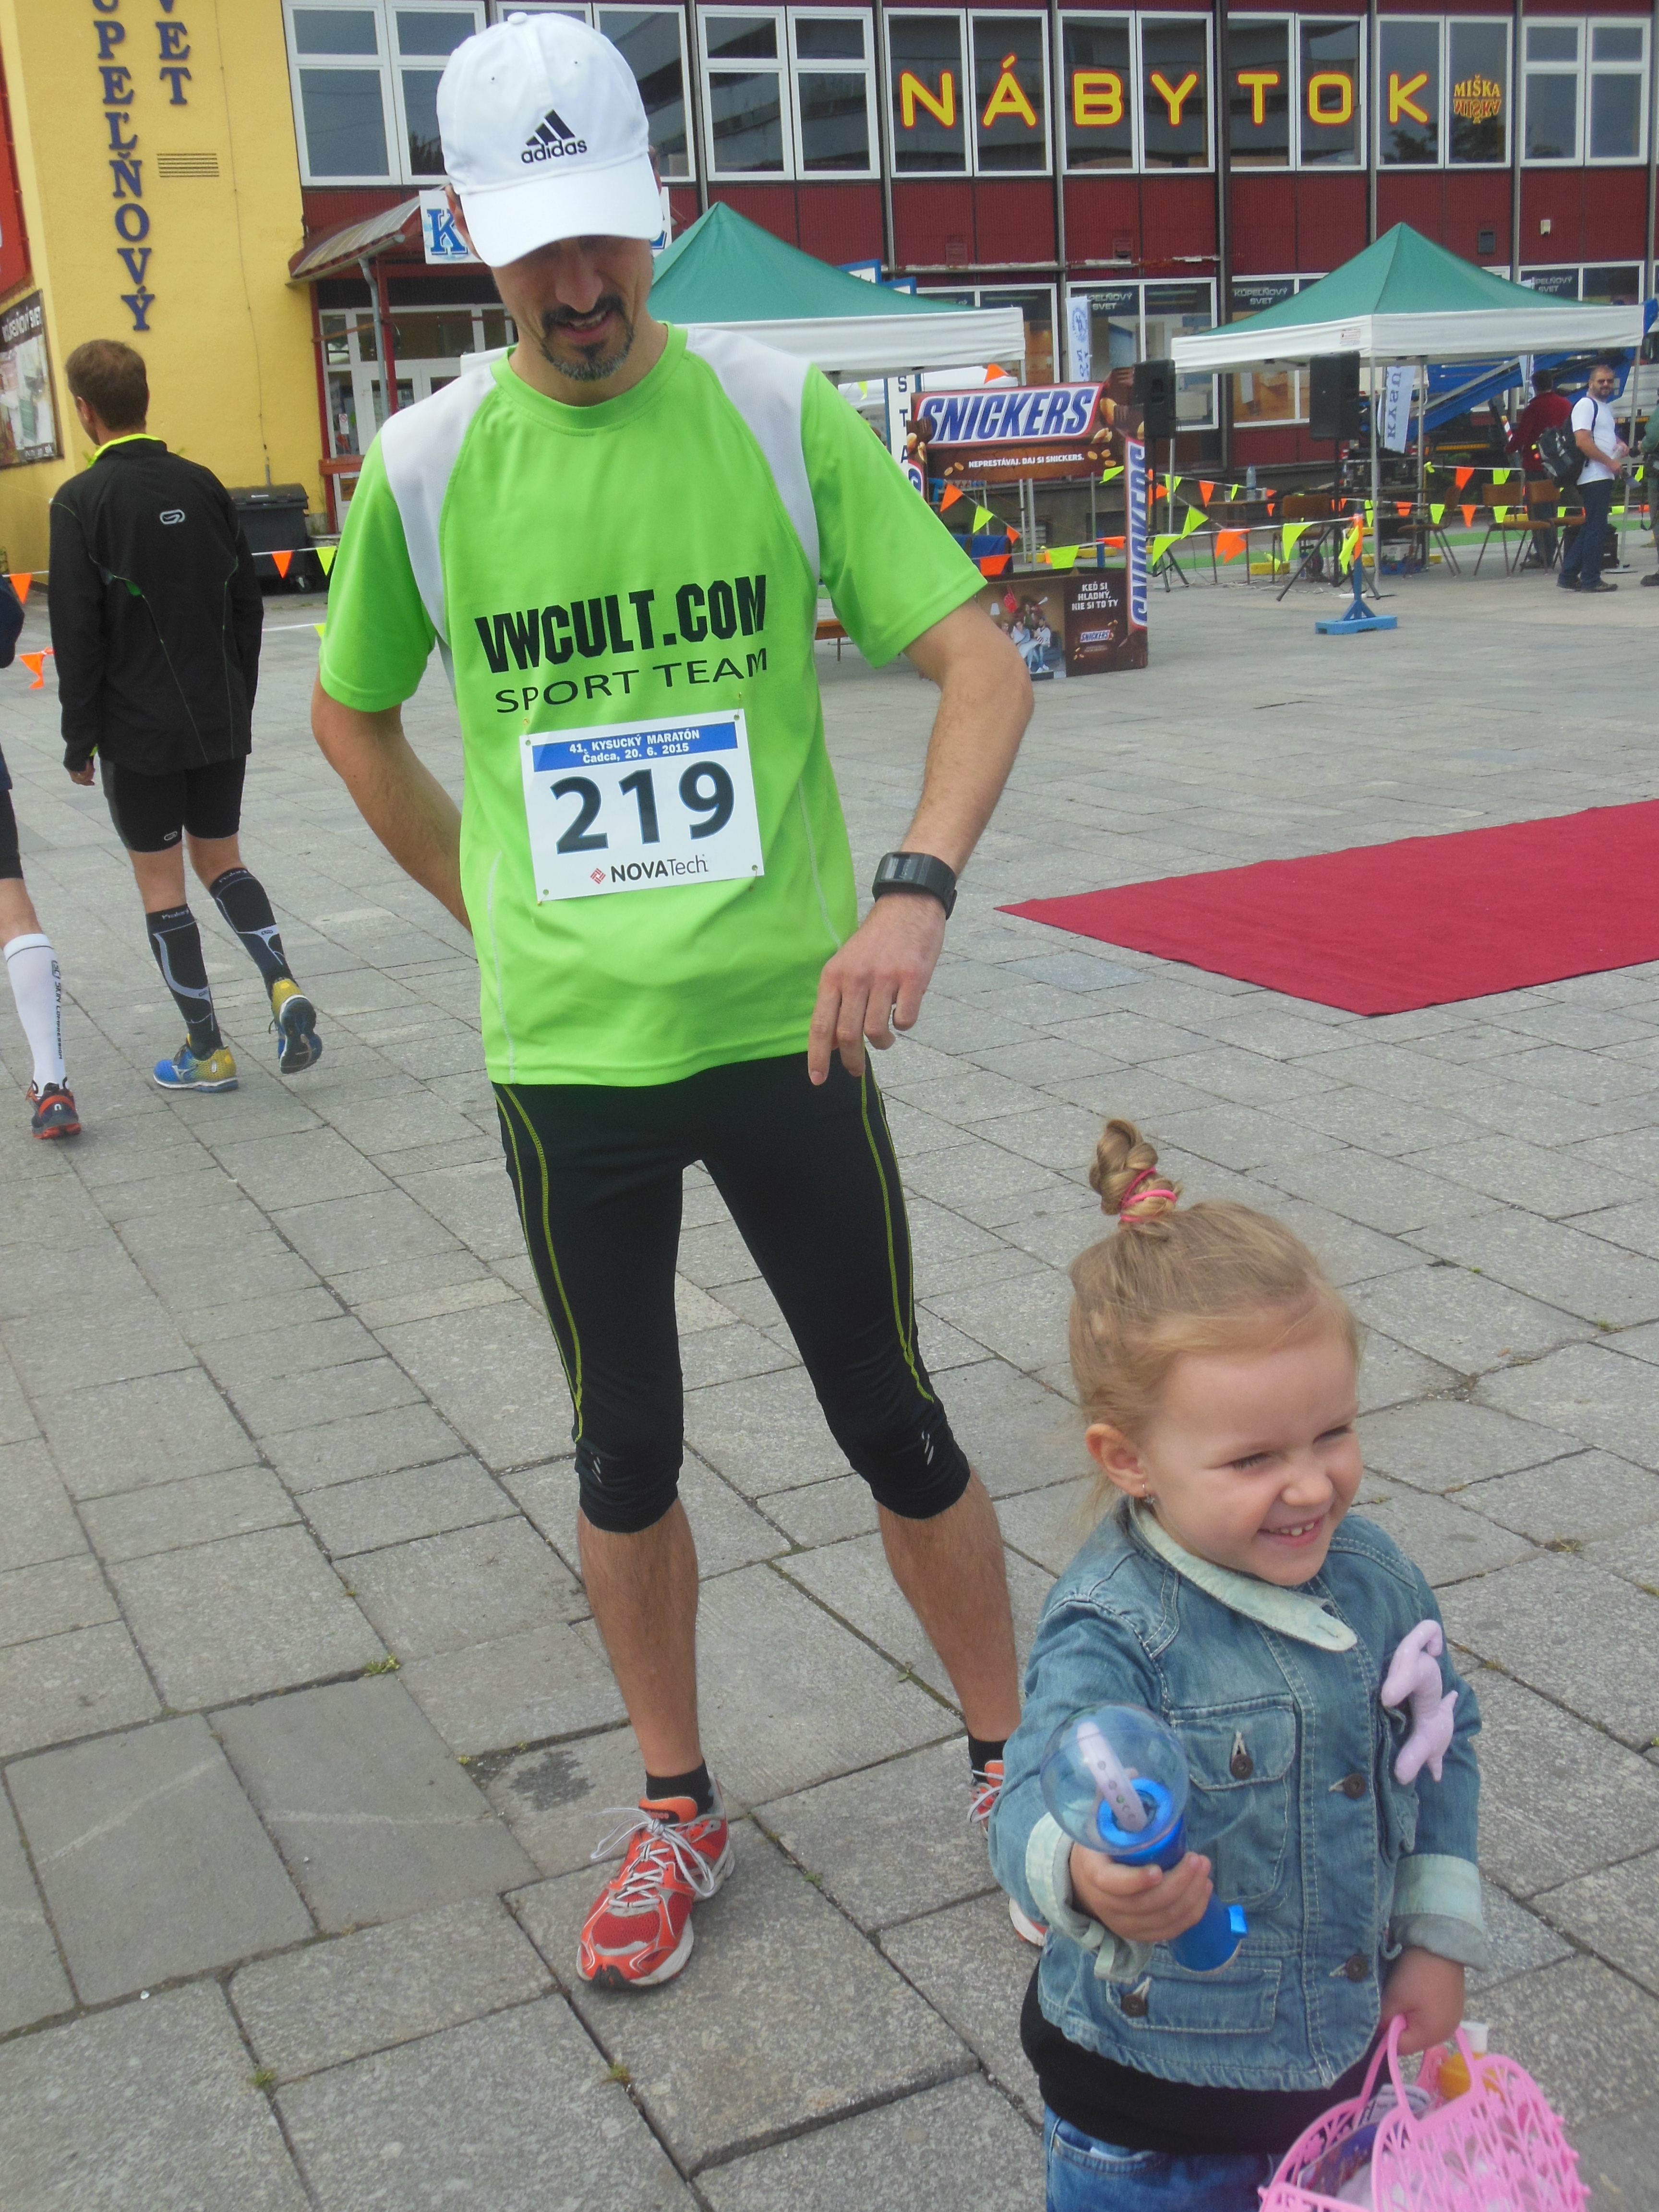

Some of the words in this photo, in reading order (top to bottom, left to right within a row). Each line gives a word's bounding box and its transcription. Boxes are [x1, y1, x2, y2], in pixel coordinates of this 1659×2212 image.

[900, 52, 1430, 129] NÁBYTOK
[1454, 74, 1501, 97] MIŠKA
[521, 139, 587, 163] adidas
[1092, 302, 1117, 310] SVET
[923, 388, 1096, 441] SNICKERS
[968, 457, 1021, 468] NEPRESTÁVAJ.
[1046, 454, 1084, 463] SNICKERS.
[1078, 589, 1111, 601] HLADNÝ,
[1082, 581, 1098, 591] KEĎ
[1100, 582, 1107, 590] SI
[1072, 602, 1085, 611] NIE
[1096, 600, 1106, 608] TO
[1108, 599, 1118, 607] TY
[474, 574, 766, 673] VWCULT.COM
[1081, 630, 1110, 641] SNICKERS
[495, 670, 639, 713] SPORT
[653, 648, 767, 687] TEAM
[569, 744, 587, 753] 41.
[591, 734, 642, 751] KYSUCKÝ
[647, 728, 700, 744] MARATÓN
[583, 752, 620, 763] Čadca,
[625, 748, 642, 758] 20.
[647, 747, 657, 756] 6.
[662, 743, 689, 754] 2015
[550, 760, 734, 854] 219
[611, 854, 709, 883] NOVATech
